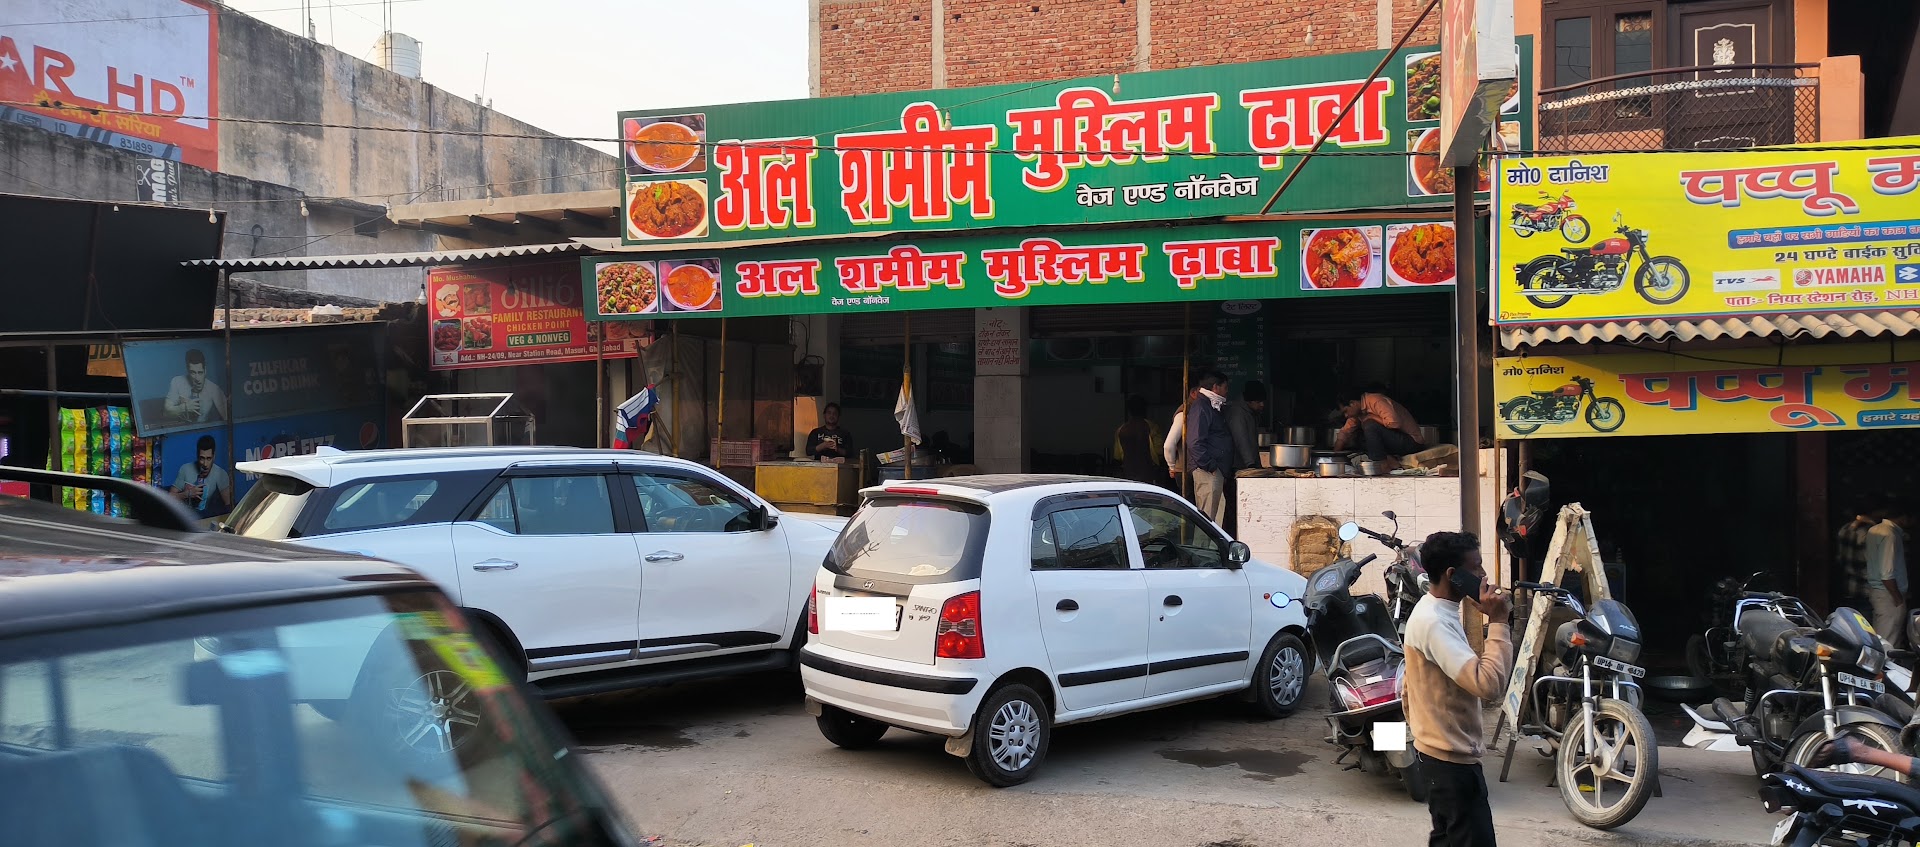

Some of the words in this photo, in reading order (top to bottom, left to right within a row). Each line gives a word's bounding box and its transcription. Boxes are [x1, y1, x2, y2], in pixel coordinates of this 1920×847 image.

[107, 66, 186, 116] HD
[115, 115, 162, 138] सरिया
[120, 137, 153, 154] 831899
[714, 136, 816, 229] अल
[835, 101, 996, 224] शमीम
[1006, 88, 1217, 190] मुस्लिम
[150, 158, 167, 202] MAG
[1547, 159, 1609, 183] दानिश
[1076, 183, 1115, 207] वेज
[1121, 182, 1169, 206] एण्ड
[1172, 172, 1259, 201] नॉनवेज
[1680, 160, 1860, 215] पप्पू
[1775, 252, 1799, 263] 24
[1803, 247, 1839, 261] घण्टे
[1844, 245, 1888, 259] बाईक
[736, 259, 819, 295] अल
[836, 246, 965, 292] शमीम
[981, 238, 1145, 296] मुस्लिम
[1163, 237, 1279, 288] ढ़ाबा
[1814, 266, 1885, 285] YAMAHA
[1716, 277, 1746, 285] TVS
[1768, 292, 1802, 305] नियर
[1806, 291, 1846, 304] स्टेशन
[492, 311, 524, 324] FAMILY
[526, 308, 584, 321] RESTAURANT
[506, 322, 543, 333] CHICKEN
[545, 320, 571, 329] POINT
[508, 335, 525, 345] VEG
[527, 334, 534, 344] &
[536, 332, 569, 344] NONVEG
[508, 351, 522, 359] Near
[523, 349, 545, 358] Station
[1526, 364, 1565, 375] दानिश
[244, 378, 278, 396] COLD
[1618, 366, 1846, 429] पप्पू
[1862, 412, 1898, 423] हमारे
